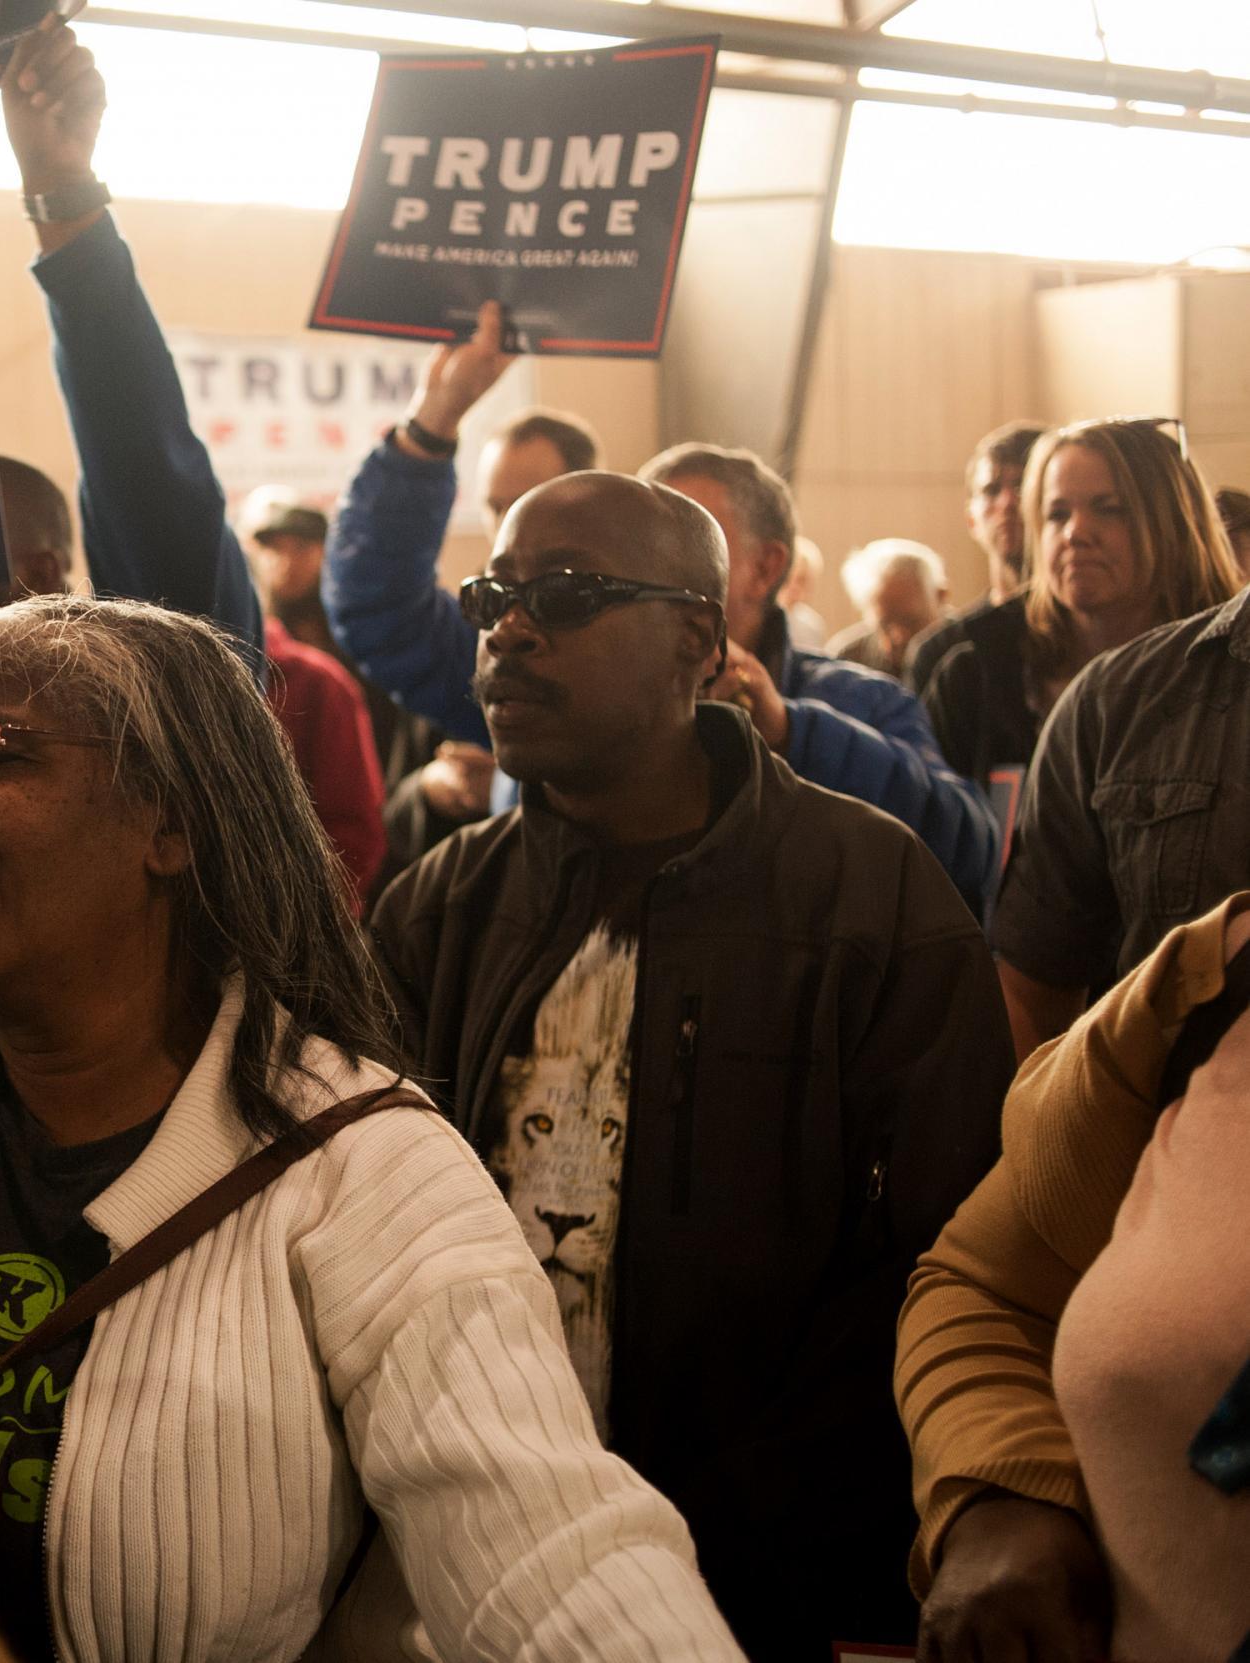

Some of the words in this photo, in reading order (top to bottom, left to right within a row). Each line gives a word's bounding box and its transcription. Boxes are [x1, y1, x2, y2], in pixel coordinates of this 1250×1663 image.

[380, 131, 681, 193] TRUMP
[392, 197, 641, 238] PENCE
[432, 246, 517, 267] AMERICA
[520, 249, 575, 268] GREAT
[183, 355, 416, 405] TRUM
